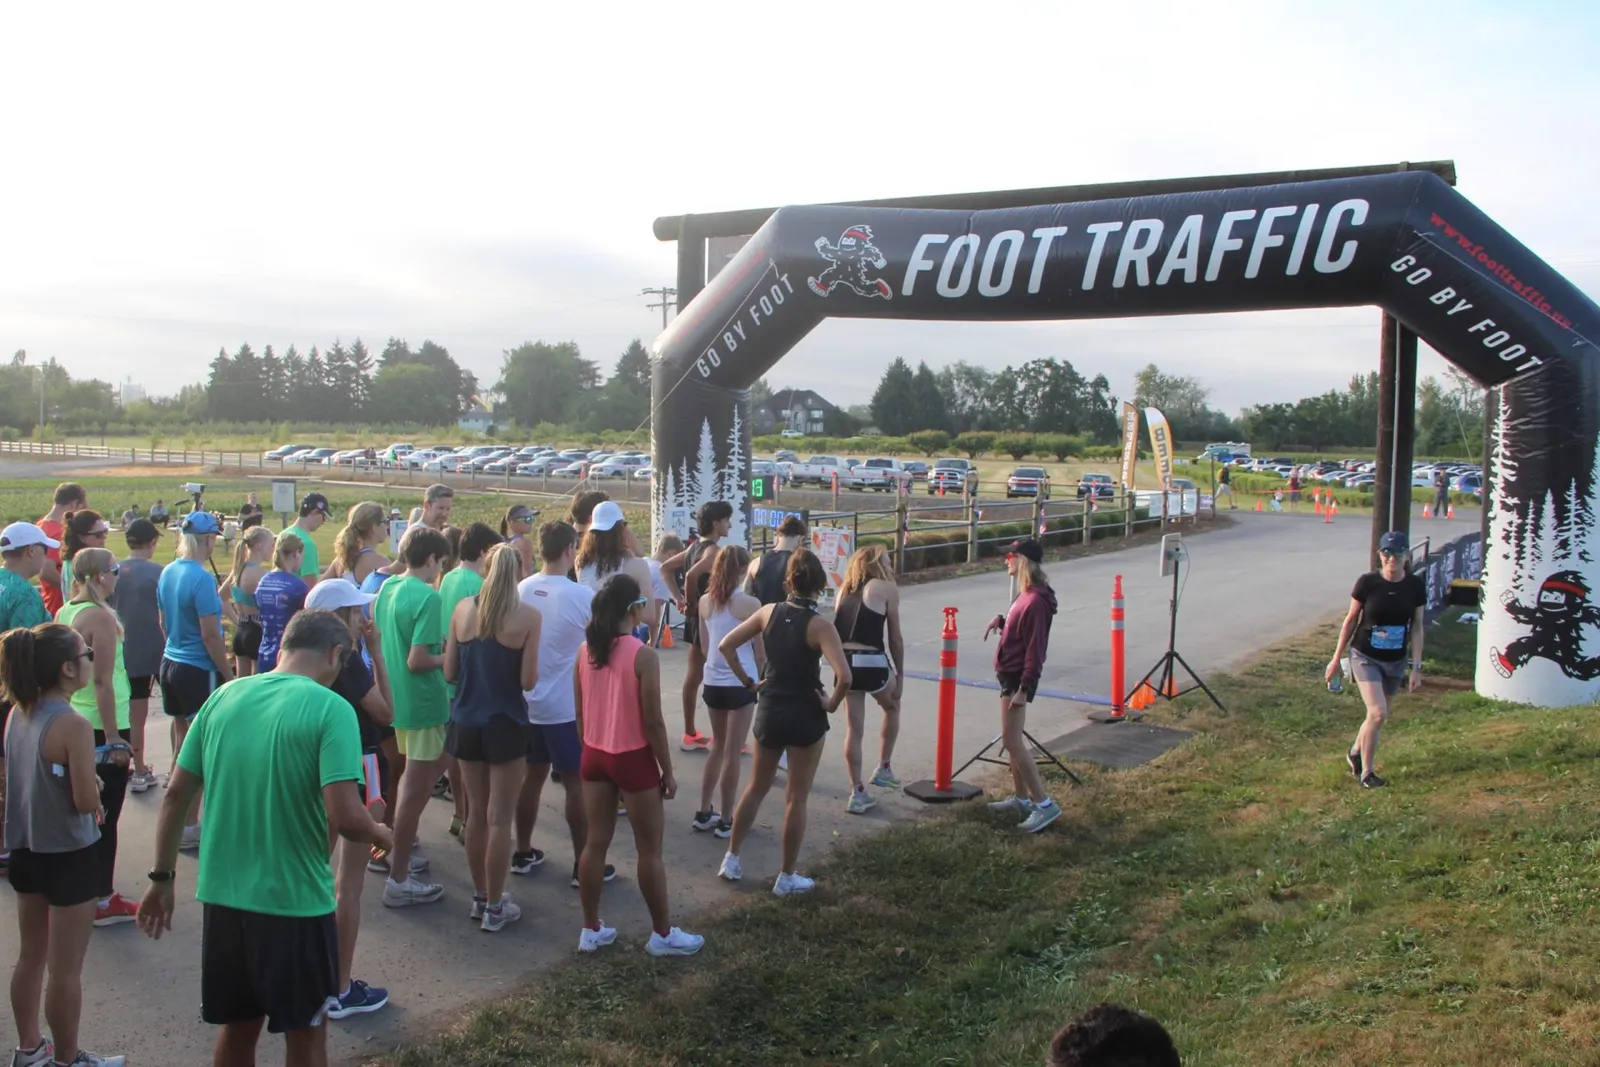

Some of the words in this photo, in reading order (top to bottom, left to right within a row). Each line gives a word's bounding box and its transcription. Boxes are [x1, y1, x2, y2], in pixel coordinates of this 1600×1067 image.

[902, 227, 1067, 298] FOOT
[1082, 198, 1370, 290] TRAFFIC
[696, 348, 721, 378] GO
[723, 320, 746, 352] BY
[749, 273, 794, 326] FOOT
[1390, 255, 1432, 285] GO
[1429, 287, 1473, 315] BY
[1468, 318, 1543, 372] FOOT
